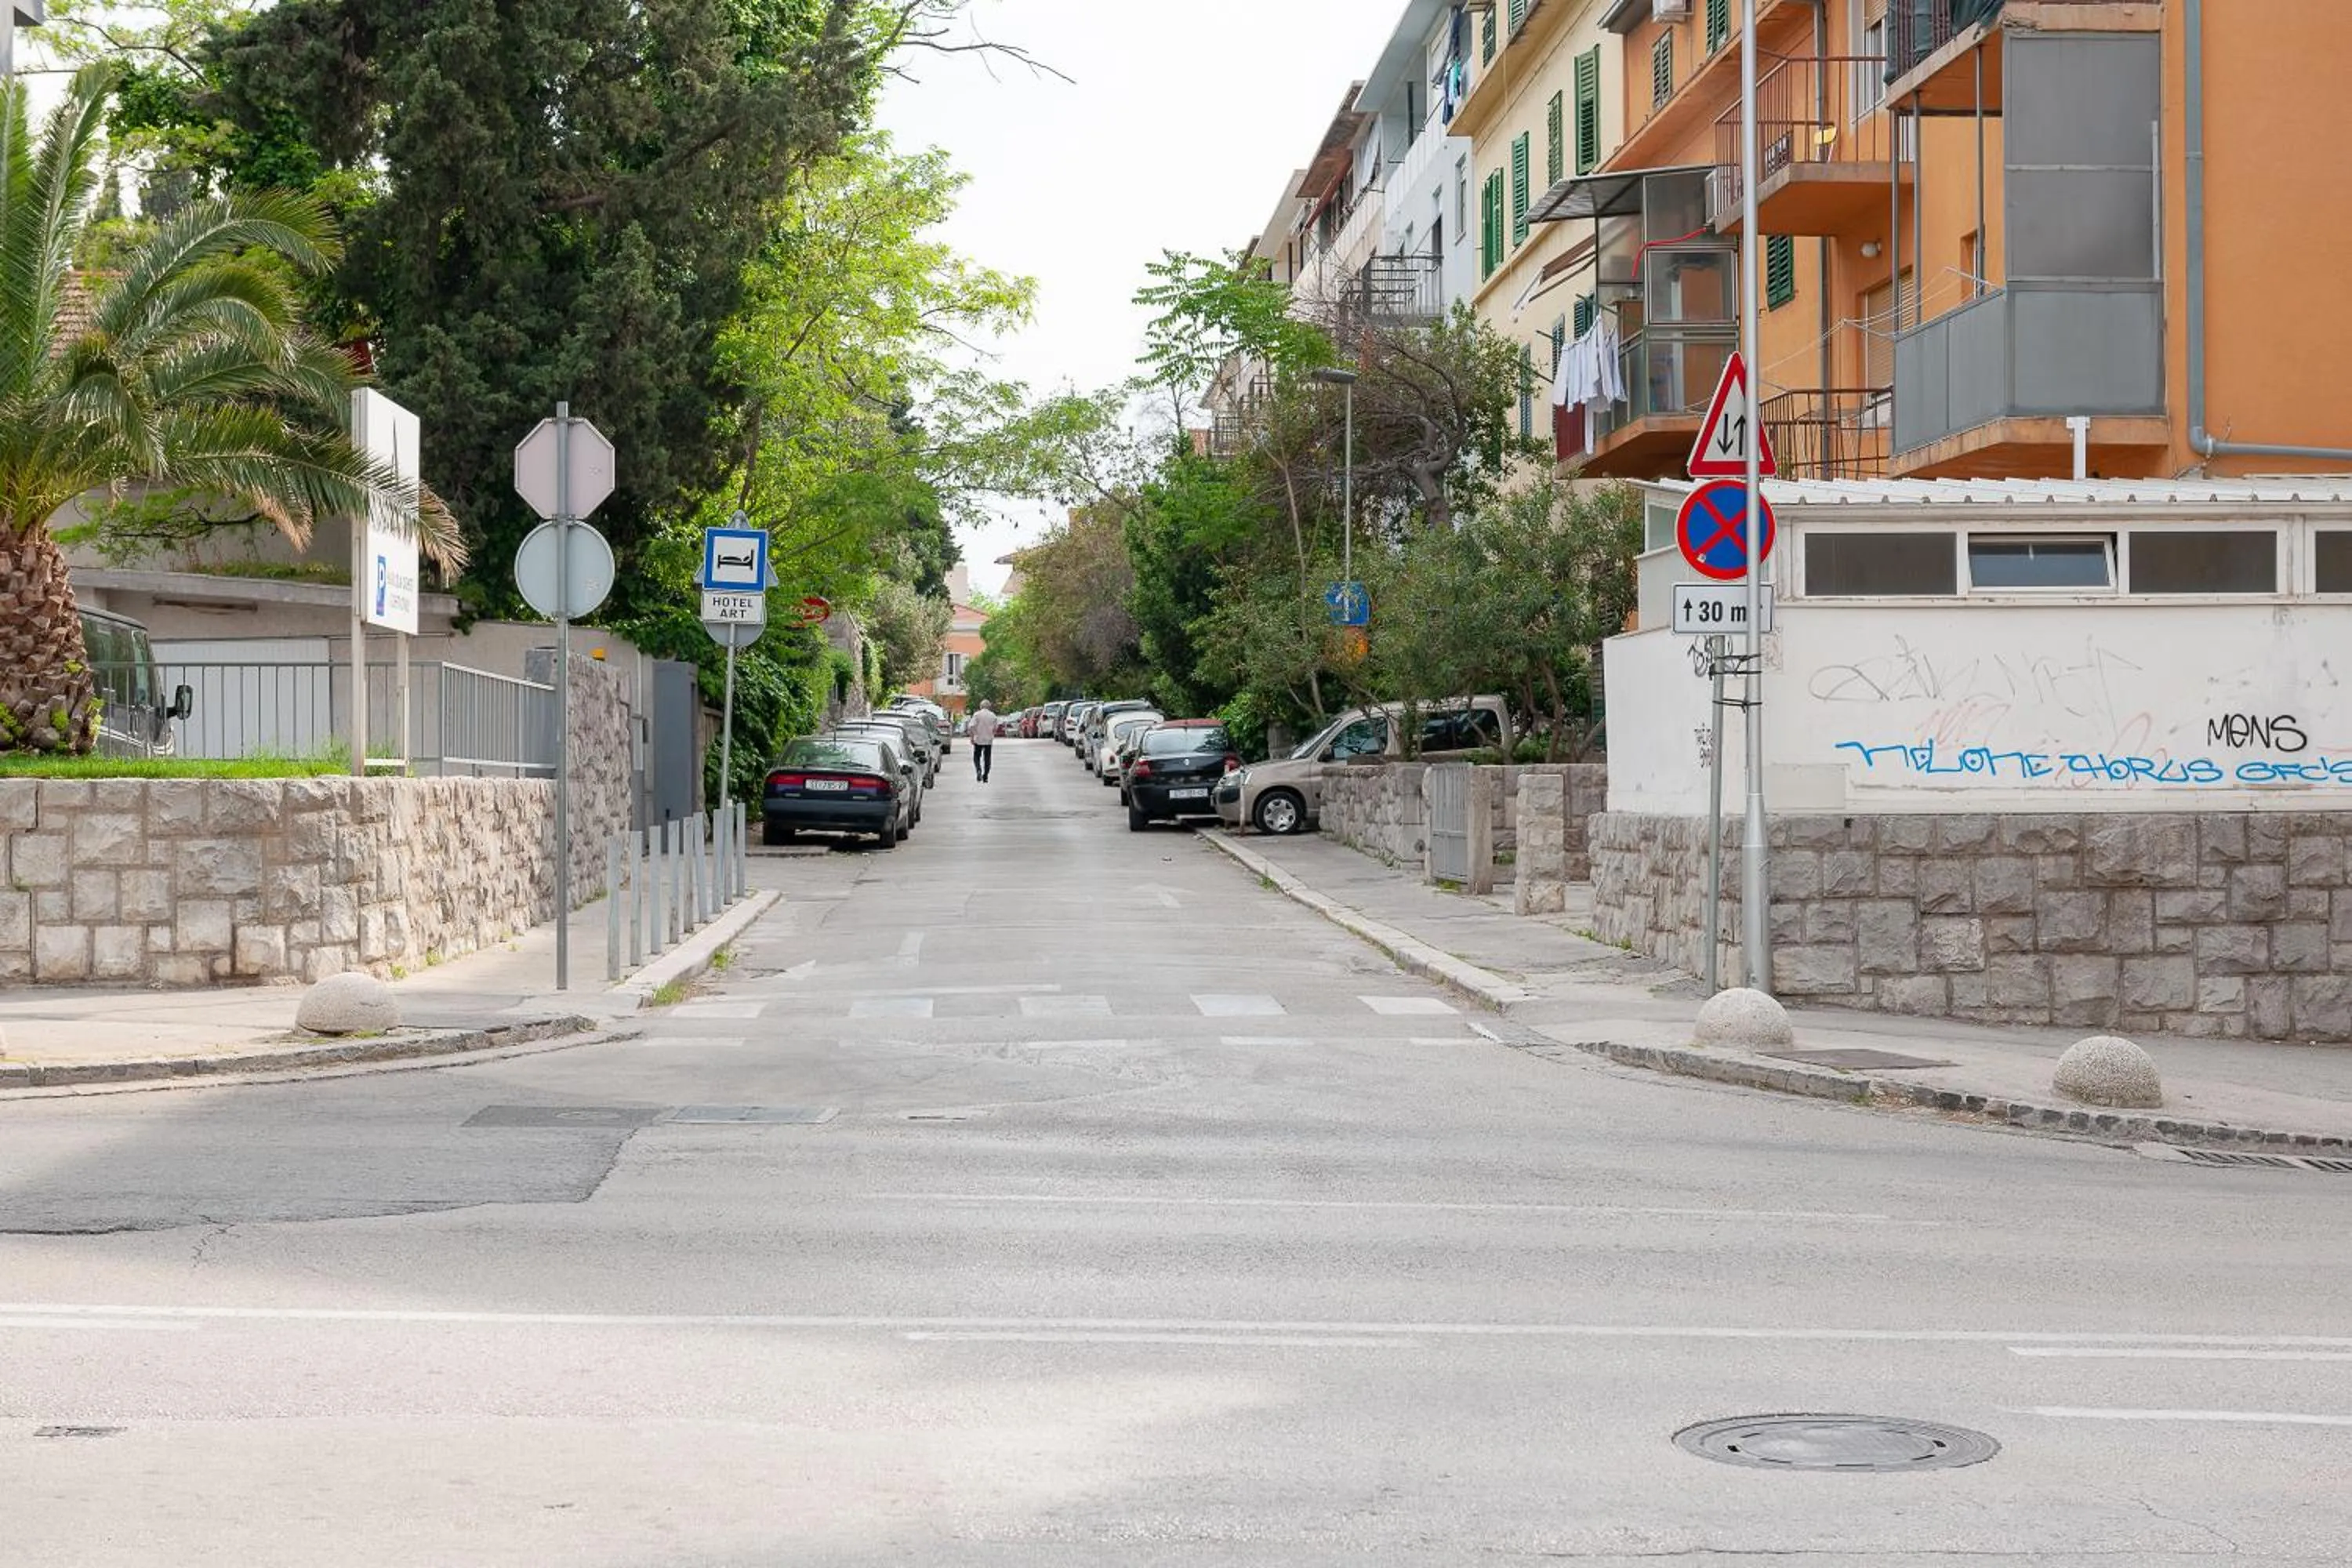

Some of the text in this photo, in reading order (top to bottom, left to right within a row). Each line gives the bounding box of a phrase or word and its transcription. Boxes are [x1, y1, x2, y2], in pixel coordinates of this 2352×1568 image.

[713, 597, 753, 608] HOTEL
[720, 608, 747, 619] ART
[1698, 601, 1747, 622] 30 m
